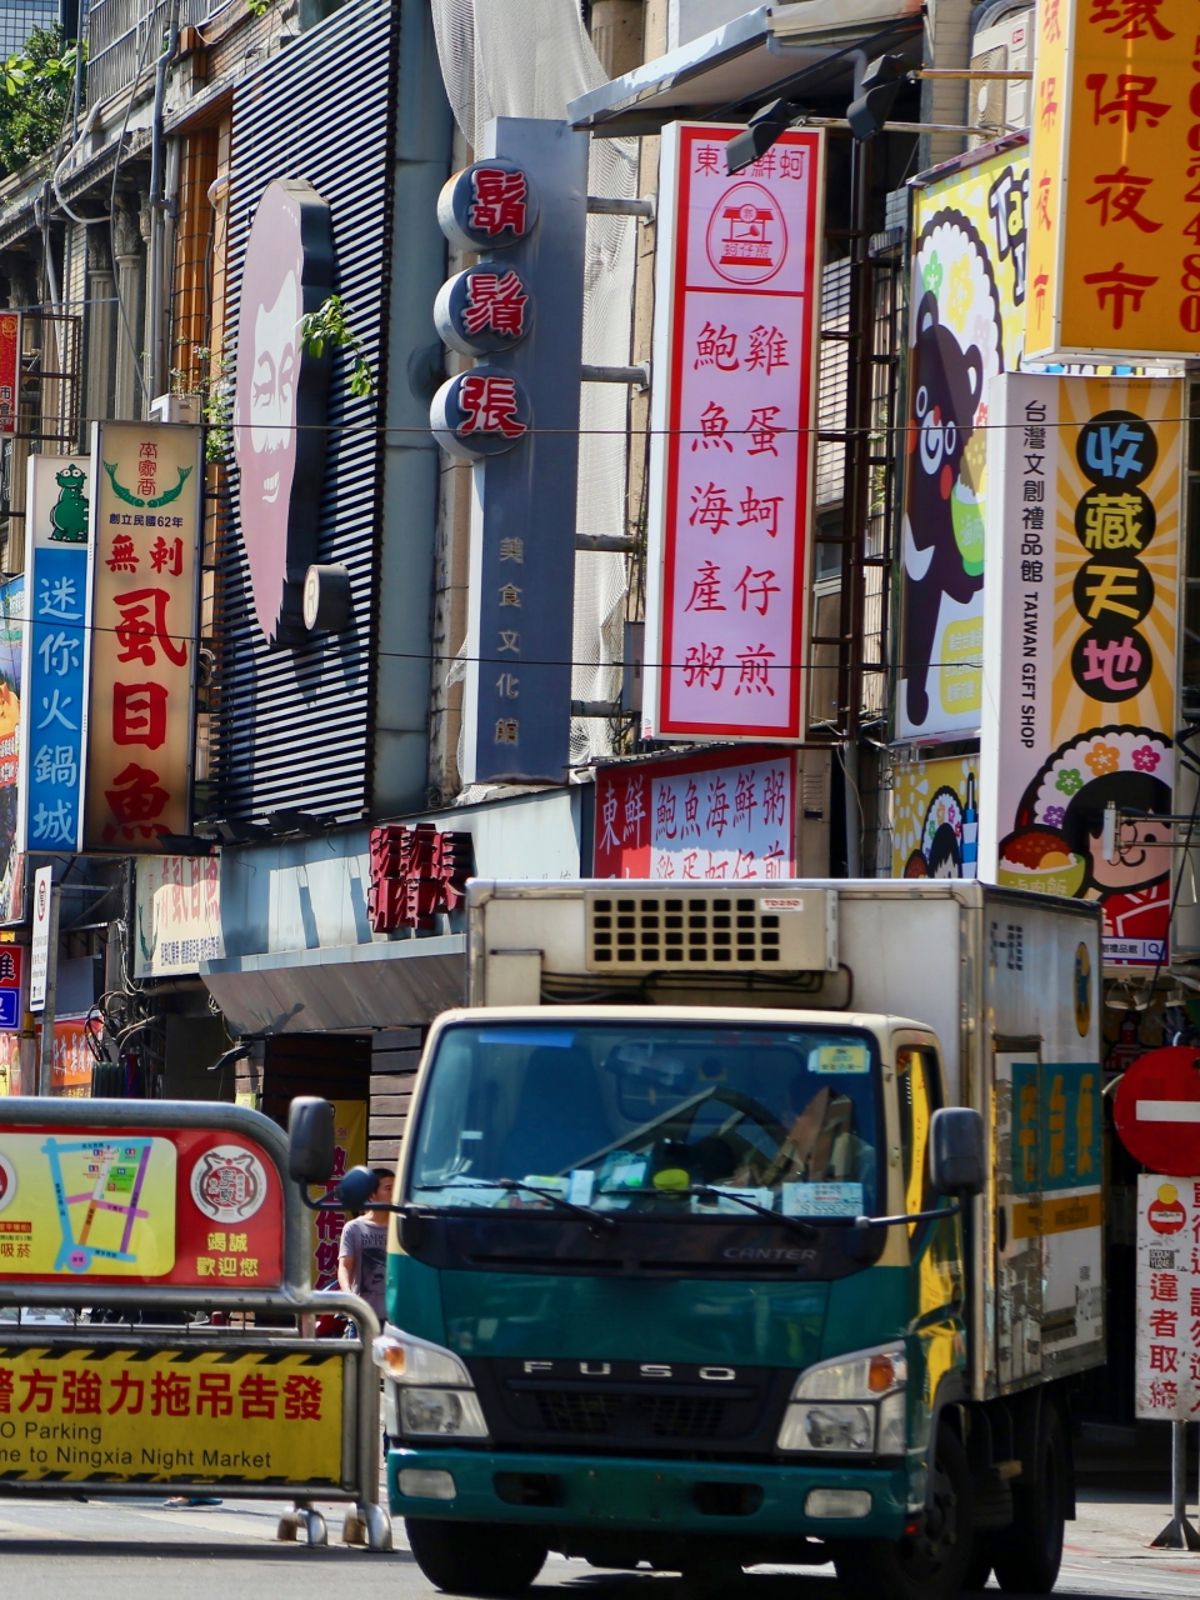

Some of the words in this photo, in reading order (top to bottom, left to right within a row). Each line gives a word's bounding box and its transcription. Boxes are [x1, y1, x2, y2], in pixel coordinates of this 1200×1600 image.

[460, 169, 528, 437] 鬍鬚張
[682, 321, 739, 692] 鮑魚海產粥
[734, 325, 790, 697] 雞蛋蚵仔煎
[1020, 400, 1046, 583] 台灣文創禮品館
[105, 535, 184, 577] 無刺
[1082, 423, 1144, 691] 收藏天地
[494, 537, 524, 746] 美食文化館
[1022, 591, 1038, 657] TAIWAN
[33, 576, 83, 846] 迷你火鍋城
[1022, 664, 1036, 701] GIFT
[102, 587, 188, 850] 虱目魚
[1021, 706, 1035, 748] SHOP
[655, 769, 785, 843] 鮑魚海鮮粥
[197, 1257, 258, 1277] 歡迎您
[208, 1232, 248, 1252] 竭誠
[724, 1246, 817, 1262] CANTER
[524, 1361, 736, 1381] FUSO
[1149, 1273, 1179, 1409] 違者取締
[24, 1422, 102, 1443] Parking
[30, 1448, 48, 1464] to
[57, 1448, 133, 1469] Ningxia
[141, 1448, 195, 1469] Night
[202, 1450, 271, 1469] Market
